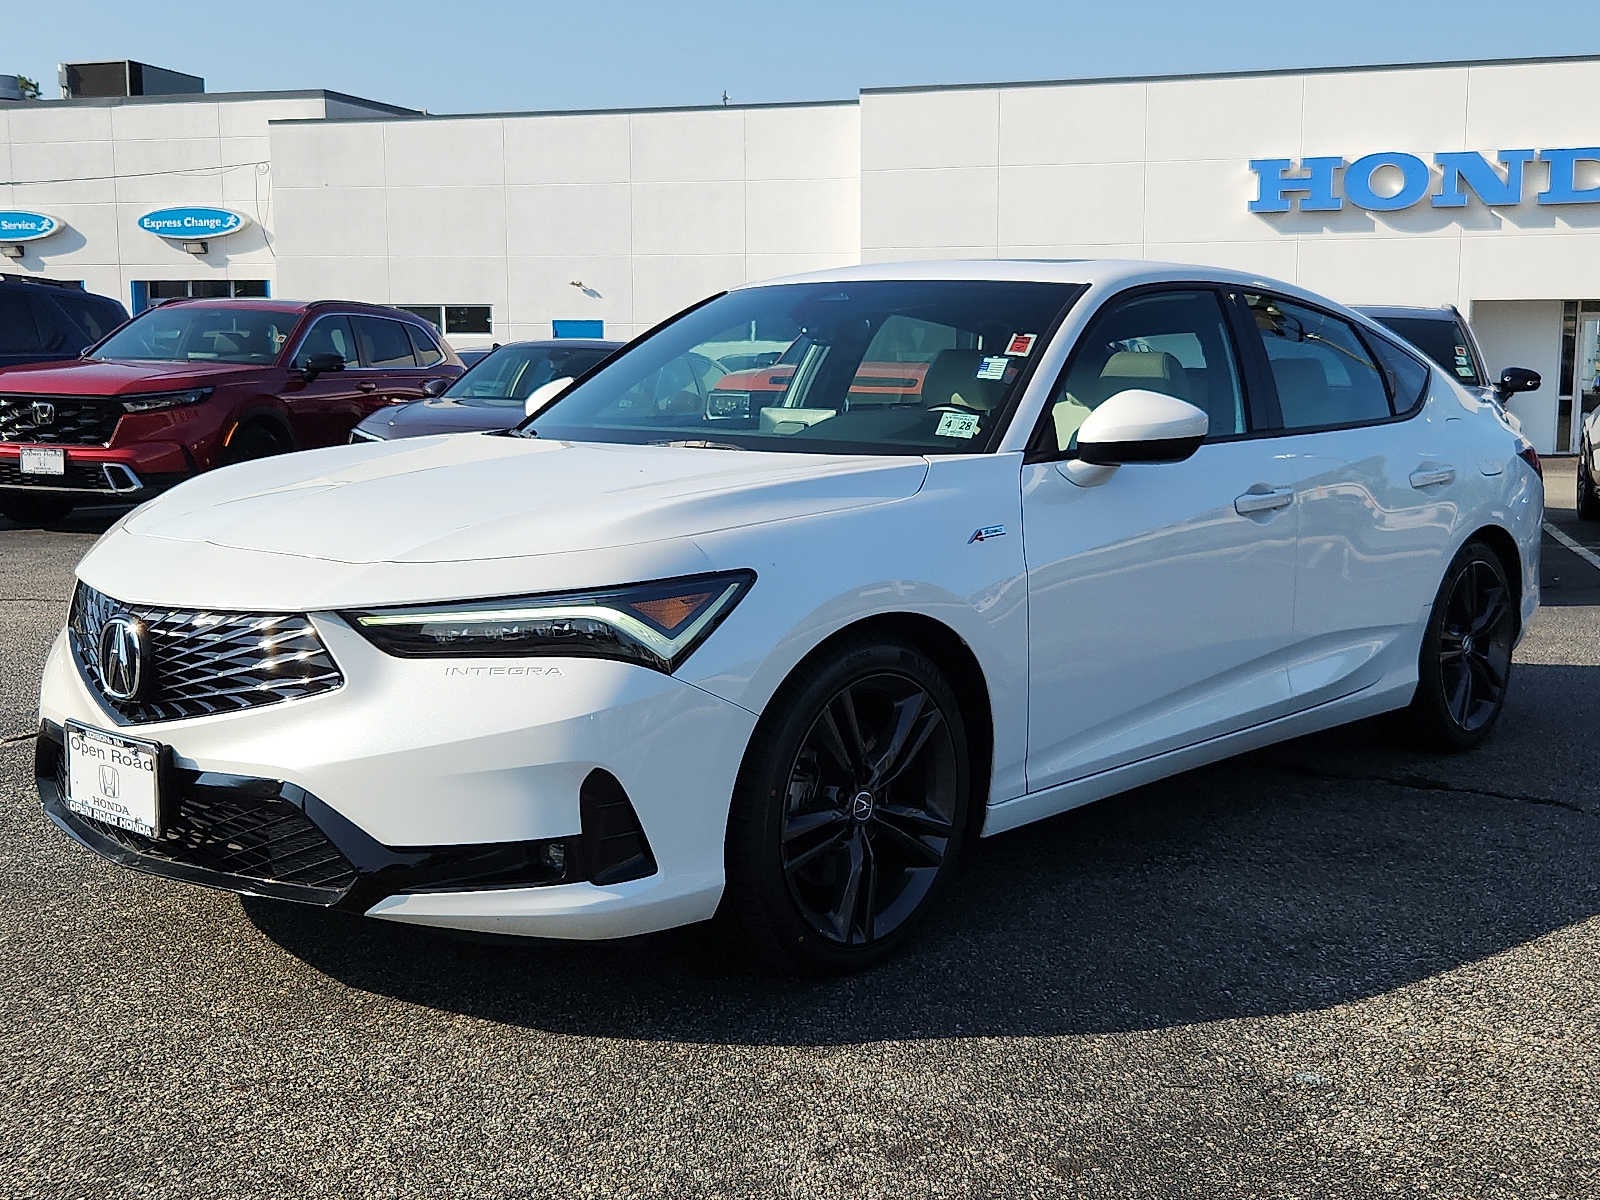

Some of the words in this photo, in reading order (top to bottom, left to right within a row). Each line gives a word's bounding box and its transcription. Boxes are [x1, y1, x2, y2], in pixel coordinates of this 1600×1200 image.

[1, 220, 37, 230] Service
[143, 217, 183, 229] Express
[183, 216, 222, 228] Change
[945, 419, 953, 429] 4
[958, 420, 973, 431] 28
[445, 666, 563, 676] INTEGRA
[70, 735, 106, 760] Open
[111, 748, 154, 772] Road
[92, 795, 131, 817] HONDA
[69, 800, 93, 819] OPEN
[93, 807, 118, 825] ROAD
[119, 816, 153, 837] HONDA
